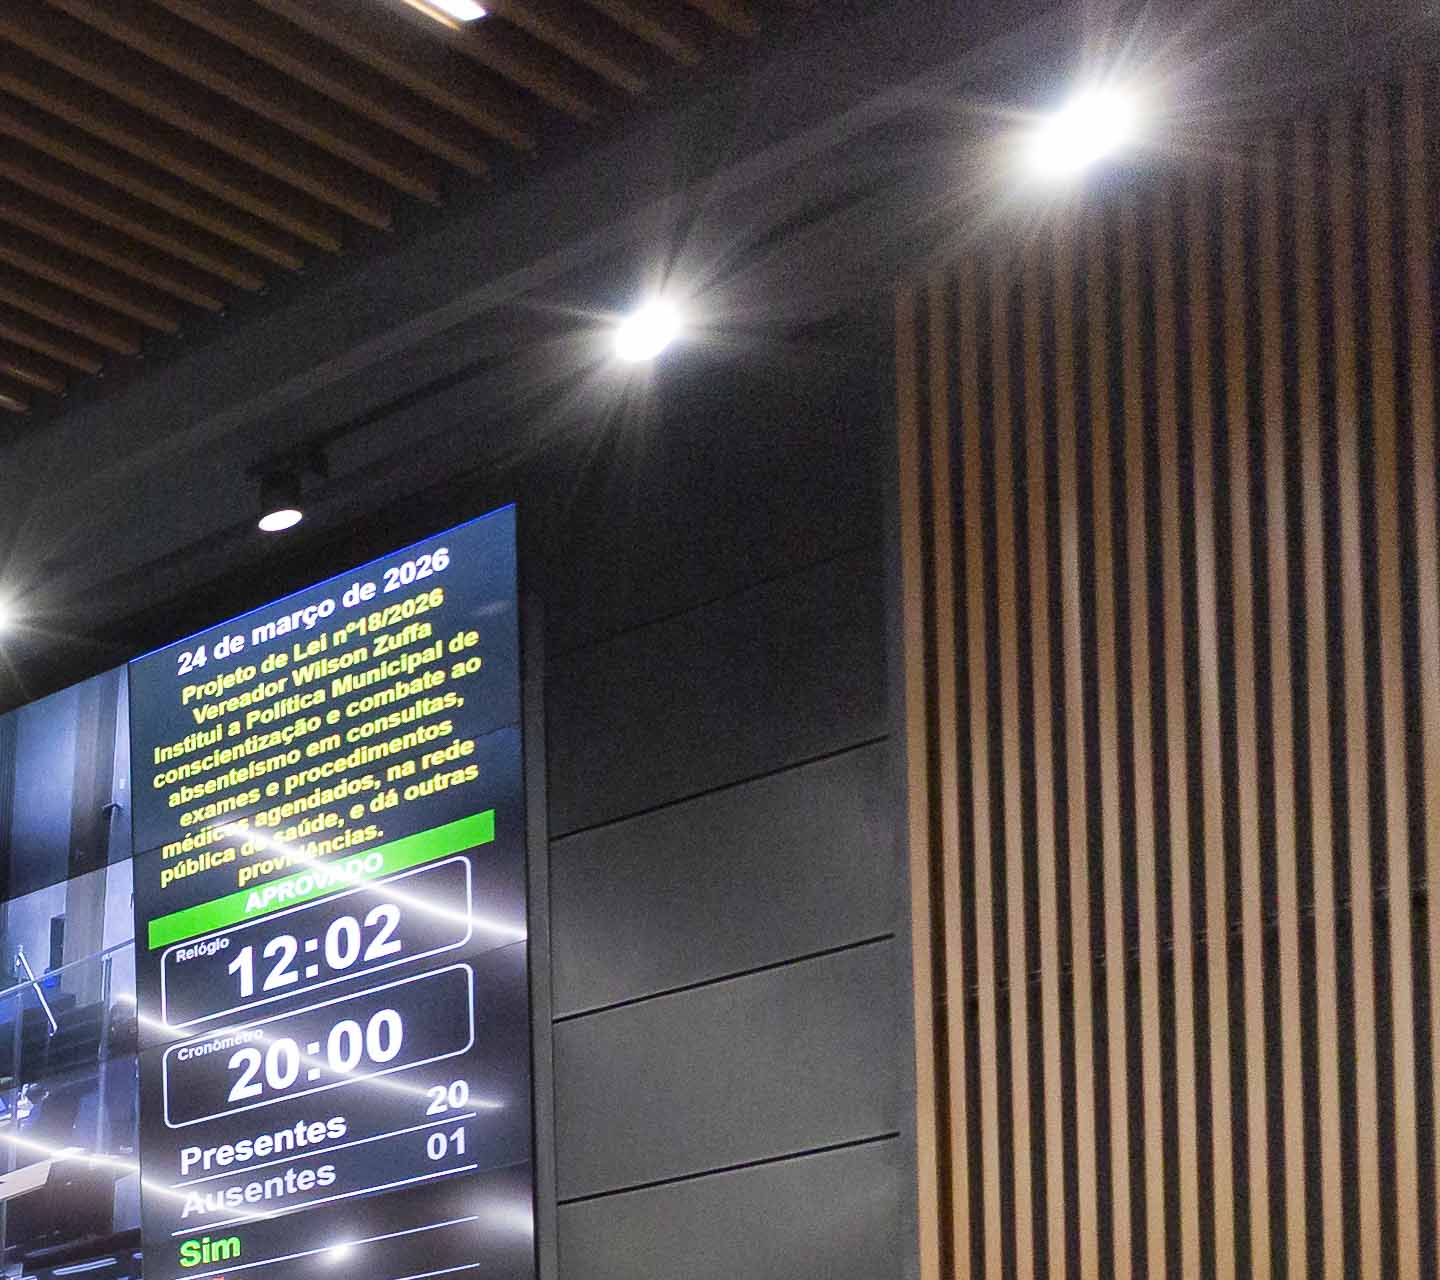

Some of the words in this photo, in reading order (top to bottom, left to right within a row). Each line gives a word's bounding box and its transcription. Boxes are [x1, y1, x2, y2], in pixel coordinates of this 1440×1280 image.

[177, 646, 207, 676] 24
[213, 634, 244, 660] de
[251, 599, 335, 645] março
[342, 582, 376, 607] de
[383, 548, 449, 593] 2026
[154, 724, 222, 764] Institui
[228, 721, 240, 737] a
[246, 689, 326, 729] Política
[332, 640, 443, 698] Municipal
[448, 631, 480, 653] de
[182, 666, 256, 705] Projeto
[261, 653, 288, 673] de
[293, 633, 328, 662] Lei
[192, 677, 288, 724] Vereador
[292, 648, 368, 687] Wilson
[373, 622, 432, 657] Zuffa
[153, 716, 321, 789] conscientização
[326, 709, 340, 724] e
[346, 670, 446, 718] combate
[451, 657, 482, 679] ao
[169, 749, 301, 807] absenteísmo
[306, 734, 341, 757] em
[346, 692, 464, 743] consultas,
[180, 788, 261, 827] exames
[266, 782, 279, 796] e
[284, 720, 453, 795] procedimentos
[255, 774, 381, 827] agendados,
[387, 760, 416, 782] na
[421, 739, 475, 770] rede
[161, 847, 236, 888] pública
[349, 804, 364, 819] e
[370, 788, 399, 813] dá
[404, 764, 479, 800] outras
[176, 936, 230, 962] Relógio
[228, 904, 402, 997] 12:02
[177, 1029, 263, 1061] Cronômetro
[228, 1009, 403, 1102] 20:00
[181, 1116, 347, 1175] Presentes
[426, 1080, 469, 1116] 20
[182, 1164, 336, 1219] Ausentes
[427, 1127, 466, 1160] 01
[180, 1236, 240, 1267] Sim
